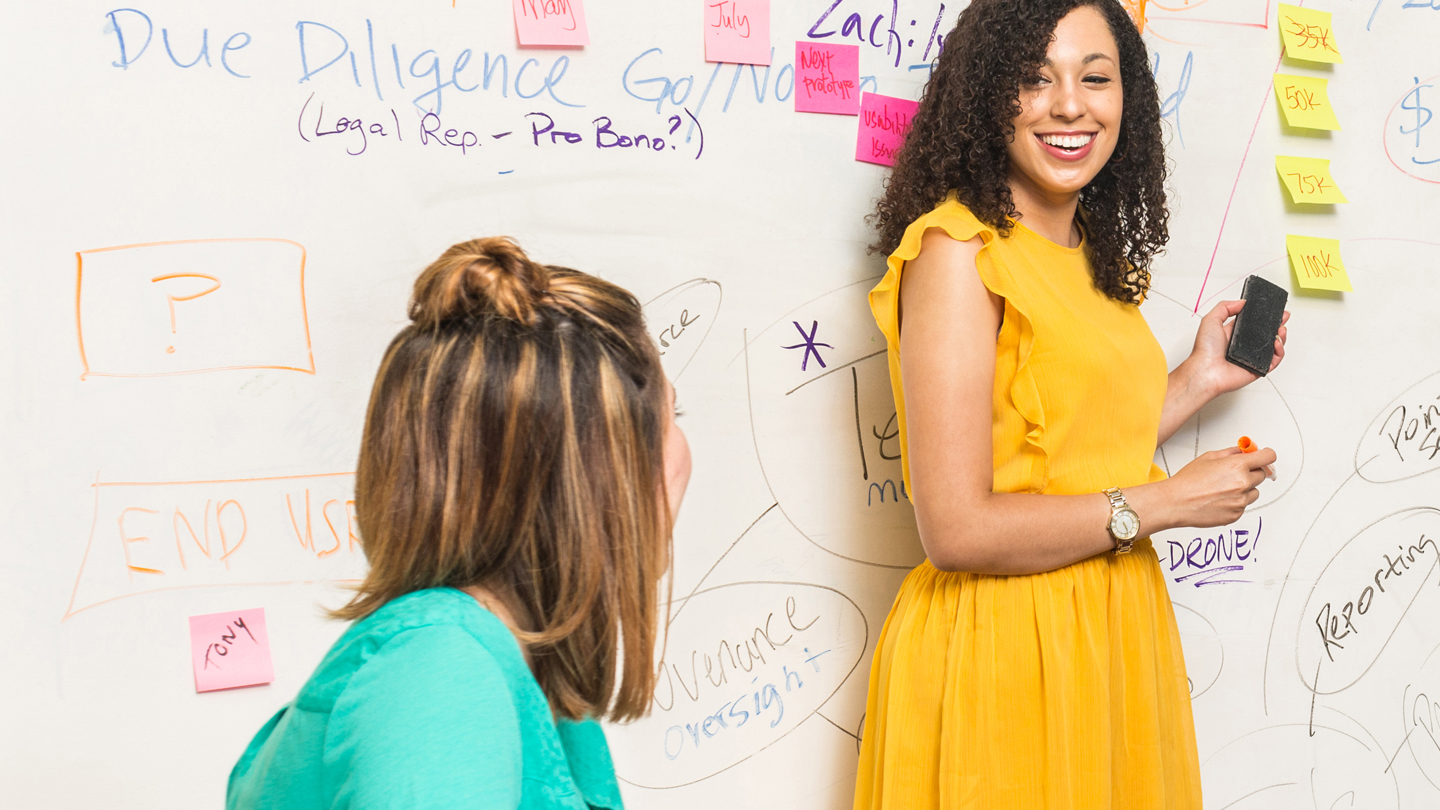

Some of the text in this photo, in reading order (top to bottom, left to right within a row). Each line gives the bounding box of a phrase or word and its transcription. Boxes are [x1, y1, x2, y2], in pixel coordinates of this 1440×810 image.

[709, 1, 750, 38] July
[106, 8, 251, 78] Due
[297, 19, 587, 117] Diligence
[801, 47, 835, 74] Next
[803, 72, 855, 100] prototype
[420, 111, 483, 149] Rep.
[525, 111, 582, 147] Pro
[864, 104, 913, 137] usabilit
[118, 498, 248, 583] END
[664, 647, 831, 761] oversight
